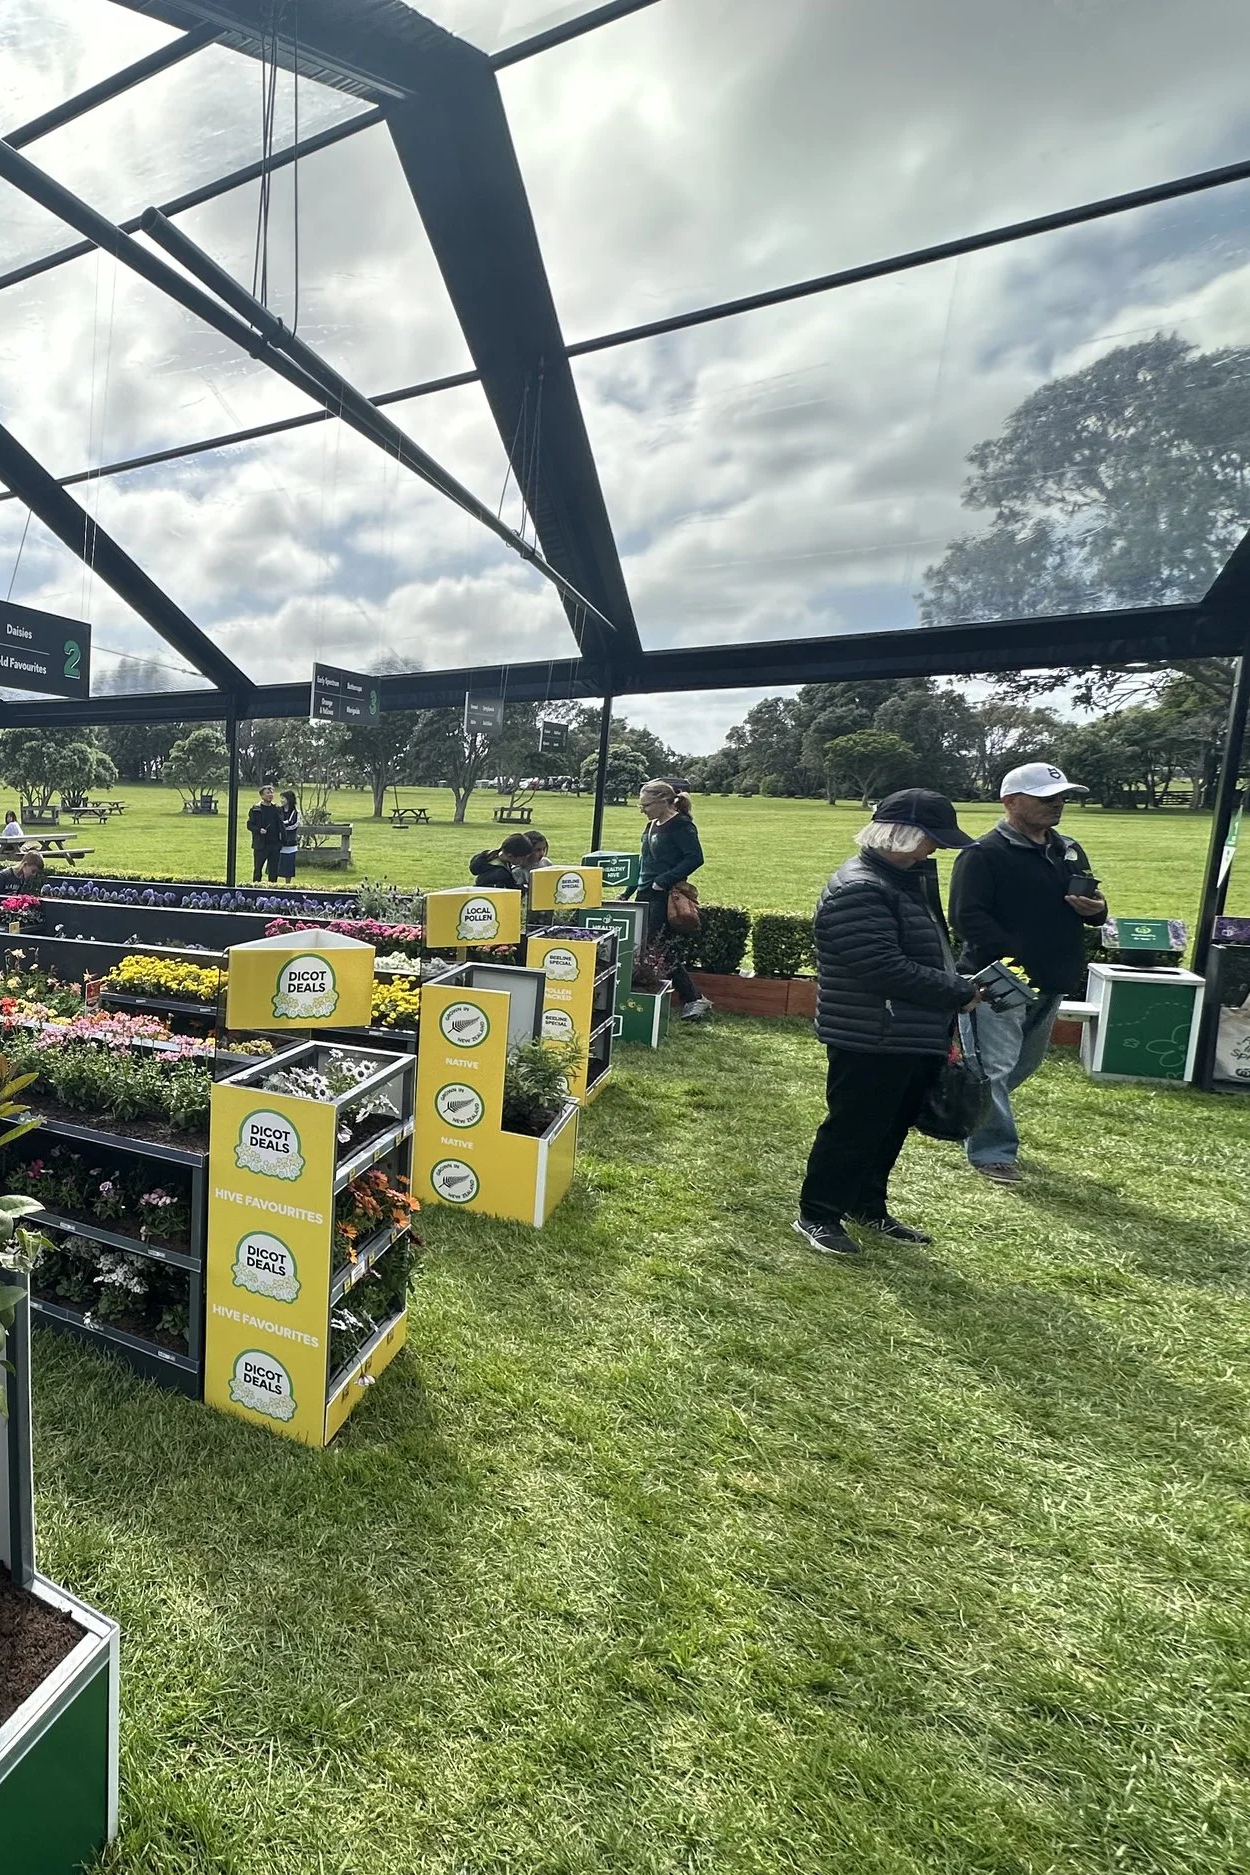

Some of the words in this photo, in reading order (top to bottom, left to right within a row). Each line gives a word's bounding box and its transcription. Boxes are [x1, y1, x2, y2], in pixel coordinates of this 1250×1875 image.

[7, 624, 32, 640] Daisies
[10, 658, 47, 674] Favourites
[64, 640, 81, 679] 2
[370, 690, 377, 714] 3
[289, 971, 326, 981] DICOT
[288, 983, 326, 993] DEALS
[446, 1057, 478, 1069] NATIVE
[440, 1088, 457, 1101] GROWN
[467, 1102, 480, 1122] ZEALAND
[251, 1124, 290, 1141] DICOT
[250, 1136, 290, 1153] DEALS
[440, 1136, 474, 1150] NATIVE
[436, 1164, 452, 1176] GROWN
[215, 1188, 243, 1204] HIVE
[246, 1195, 323, 1224] FAVOURITES
[248, 1245, 286, 1265] DICOT
[247, 1256, 286, 1276] DEALS
[212, 1303, 240, 1322] HIVE
[242, 1314, 319, 1348] FAVOURITES
[244, 1362, 282, 1384] DICOT
[244, 1373, 282, 1395] DEALS
